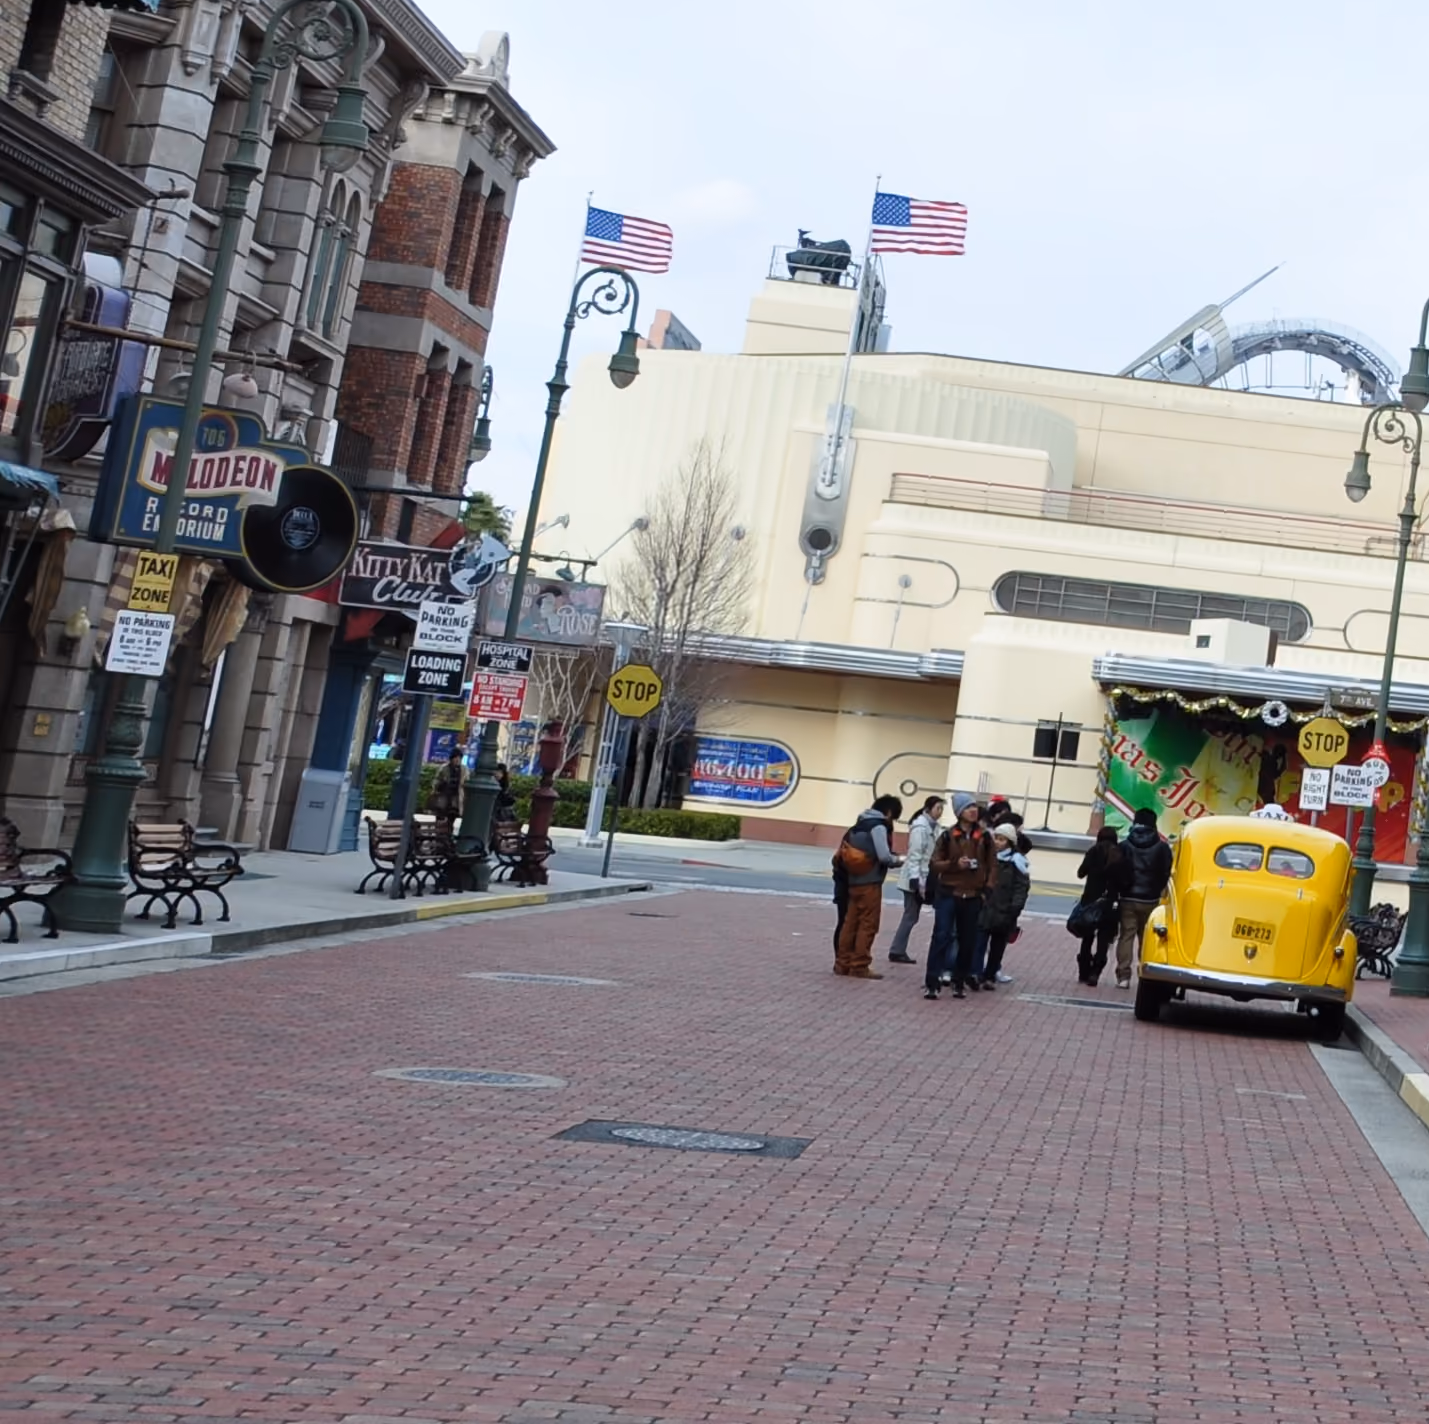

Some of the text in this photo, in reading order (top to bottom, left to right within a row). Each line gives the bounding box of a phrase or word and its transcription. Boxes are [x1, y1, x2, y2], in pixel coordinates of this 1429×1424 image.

[151, 451, 277, 492] MLODEON
[140, 557, 175, 580] TAXI
[350, 546, 446, 586] KITTY KAT
[131, 587, 170, 603] ZONE
[438, 605, 455, 616] NO
[119, 616, 170, 629] NO PARKING
[421, 611, 469, 627] PARKING
[557, 605, 597, 636] ROSE
[419, 632, 463, 643] BLOCK
[481, 644, 529, 660] HOSPITAL
[411, 655, 462, 672] LOADING
[489, 657, 518, 670] ZONE
[418, 671, 450, 686] ZONE
[477, 675, 488, 683] NO
[612, 679, 657, 702] STOP
[481, 695, 493, 705] AM
[1303, 732, 1345, 753] STOP
[1310, 773, 1322, 782] NO
[1347, 768, 1361, 776] NO
[1334, 773, 1373, 787] PARKING
[1303, 783, 1327, 794] RIGHT
[1334, 790, 1370, 799] BLOCK
[1302, 794, 1324, 805] TURN
[1256, 811, 1289, 821] TAXI
